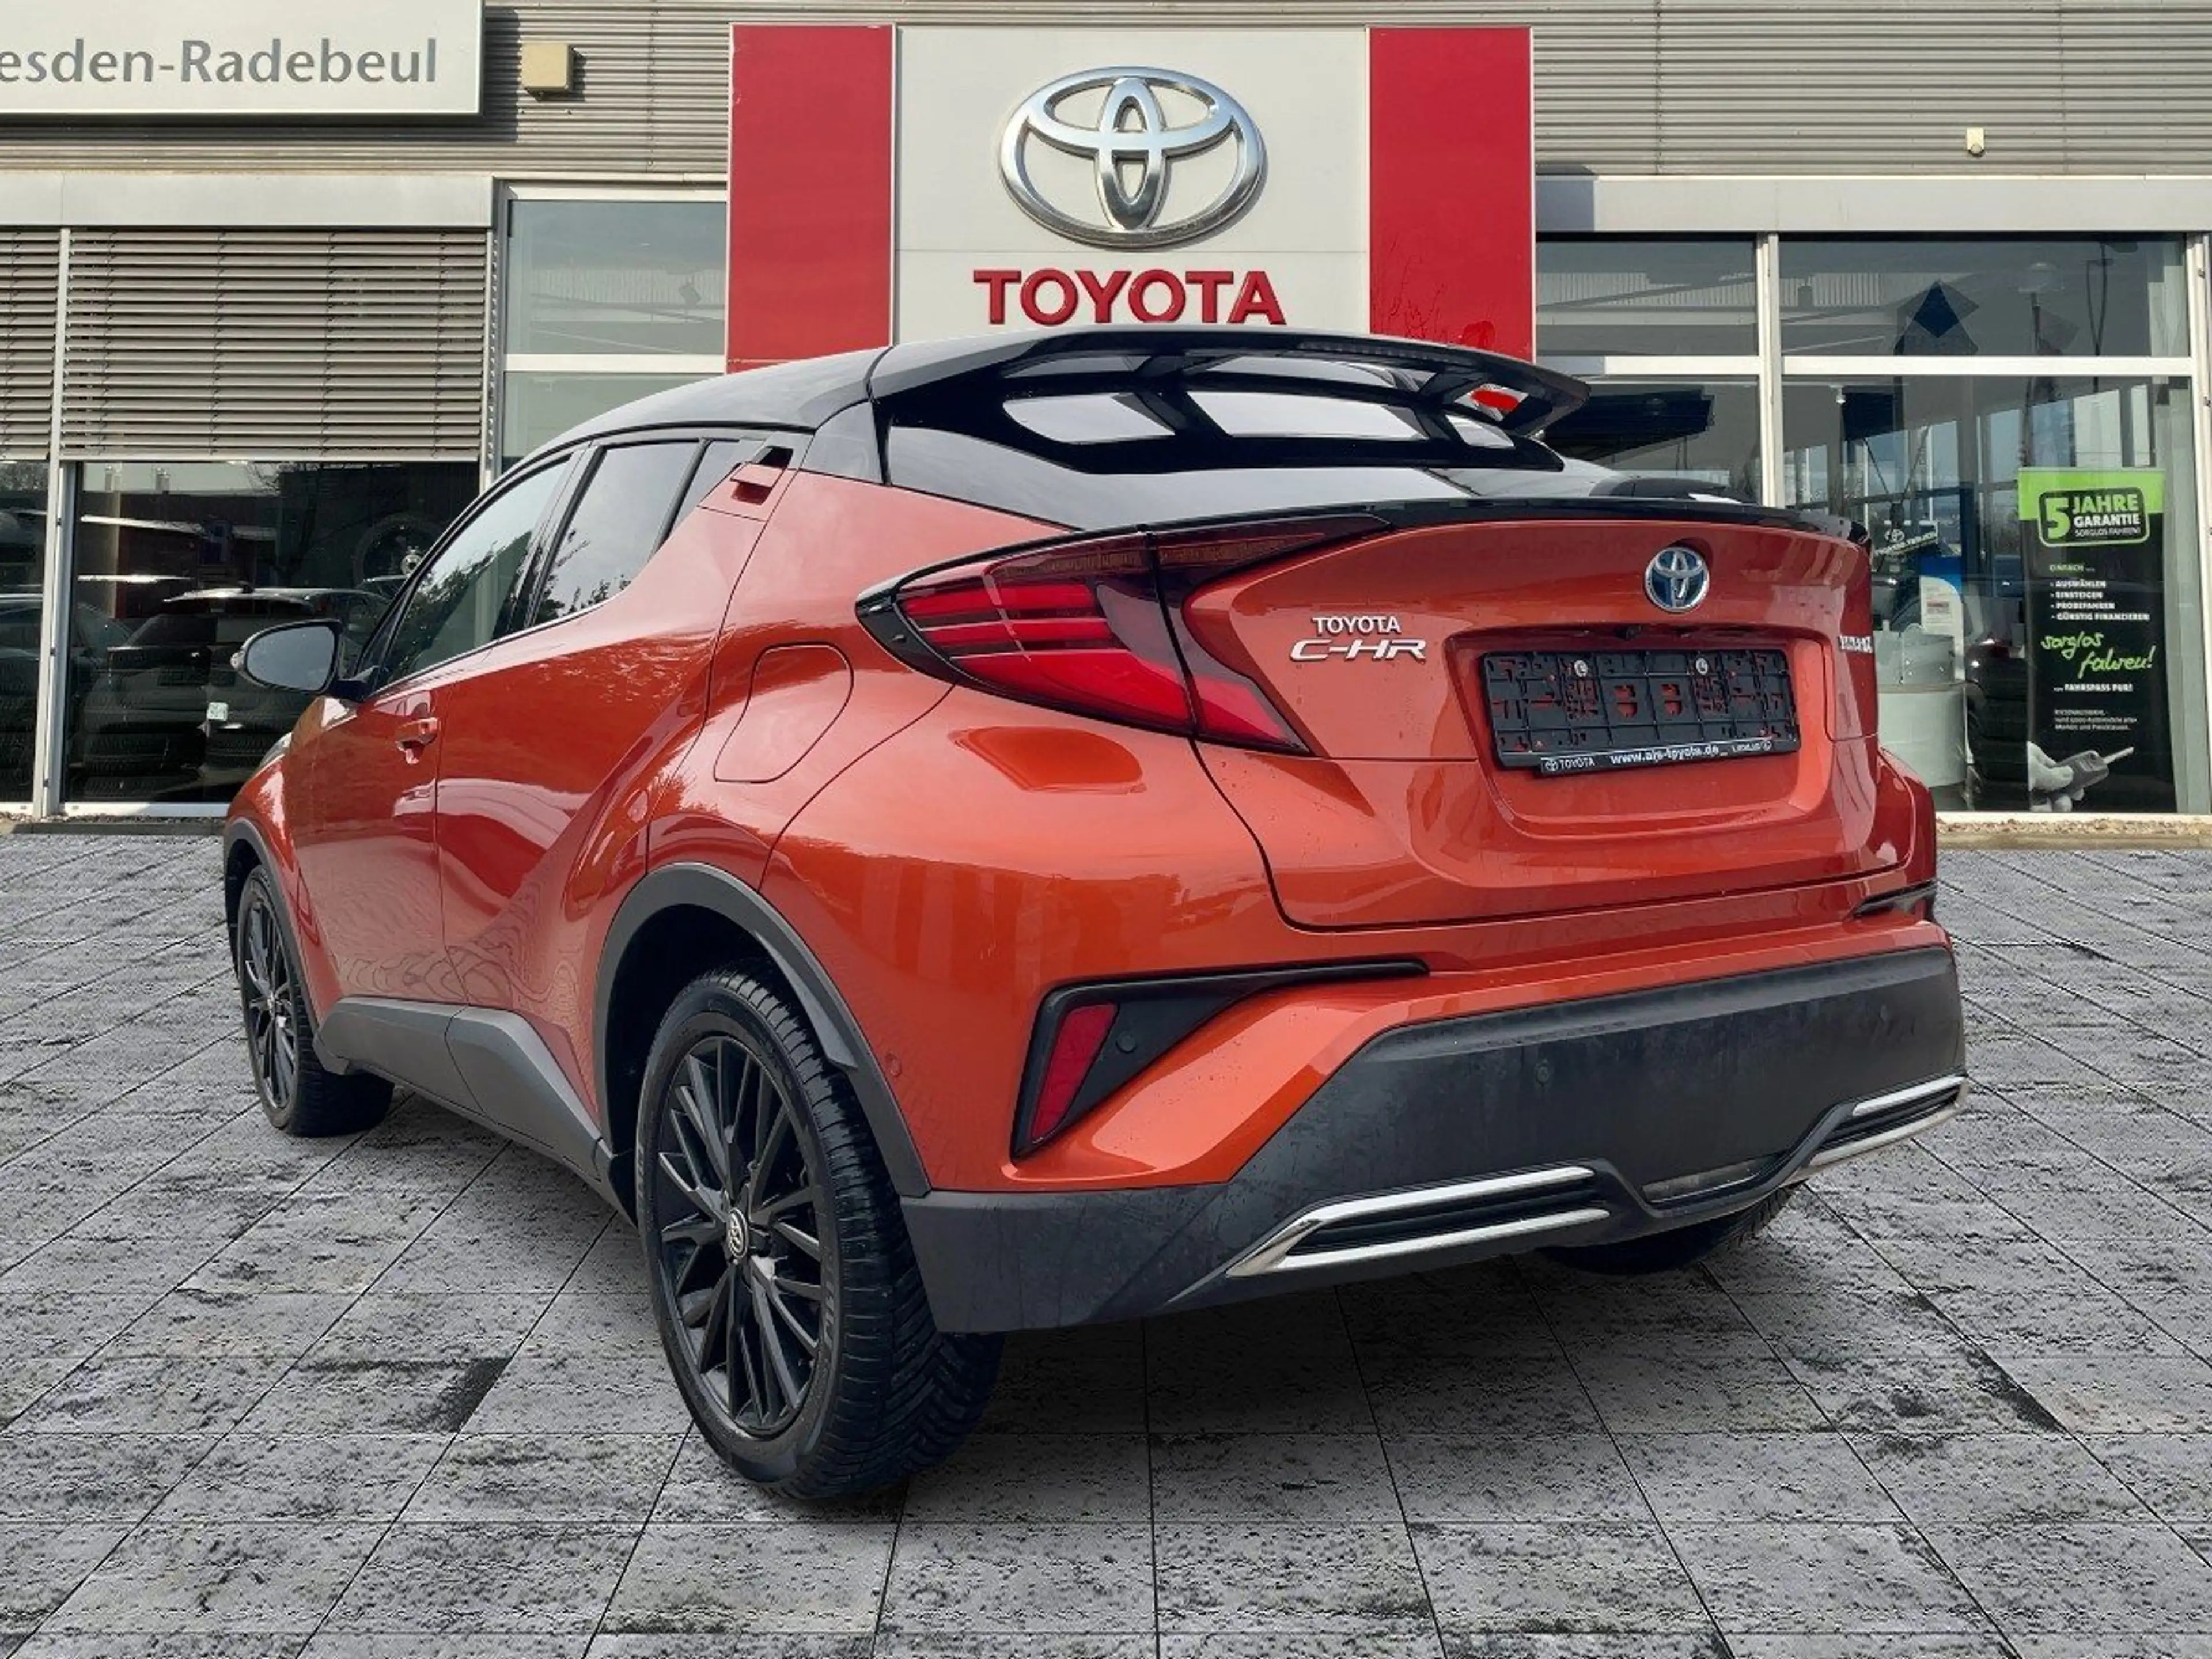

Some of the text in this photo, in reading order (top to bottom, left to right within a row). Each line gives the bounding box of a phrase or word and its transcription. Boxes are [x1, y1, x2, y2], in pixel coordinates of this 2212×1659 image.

[972, 268, 1287, 326] TOYOTA
[2073, 494, 2138, 514] JAHRE
[2045, 497, 2071, 539] 5
[2074, 514, 2141, 528] GARANTIE
[1312, 615, 1402, 635] TOYOTA
[1290, 638, 1427, 661] C-HR
[1559, 757, 1596, 770] TOYOTA
